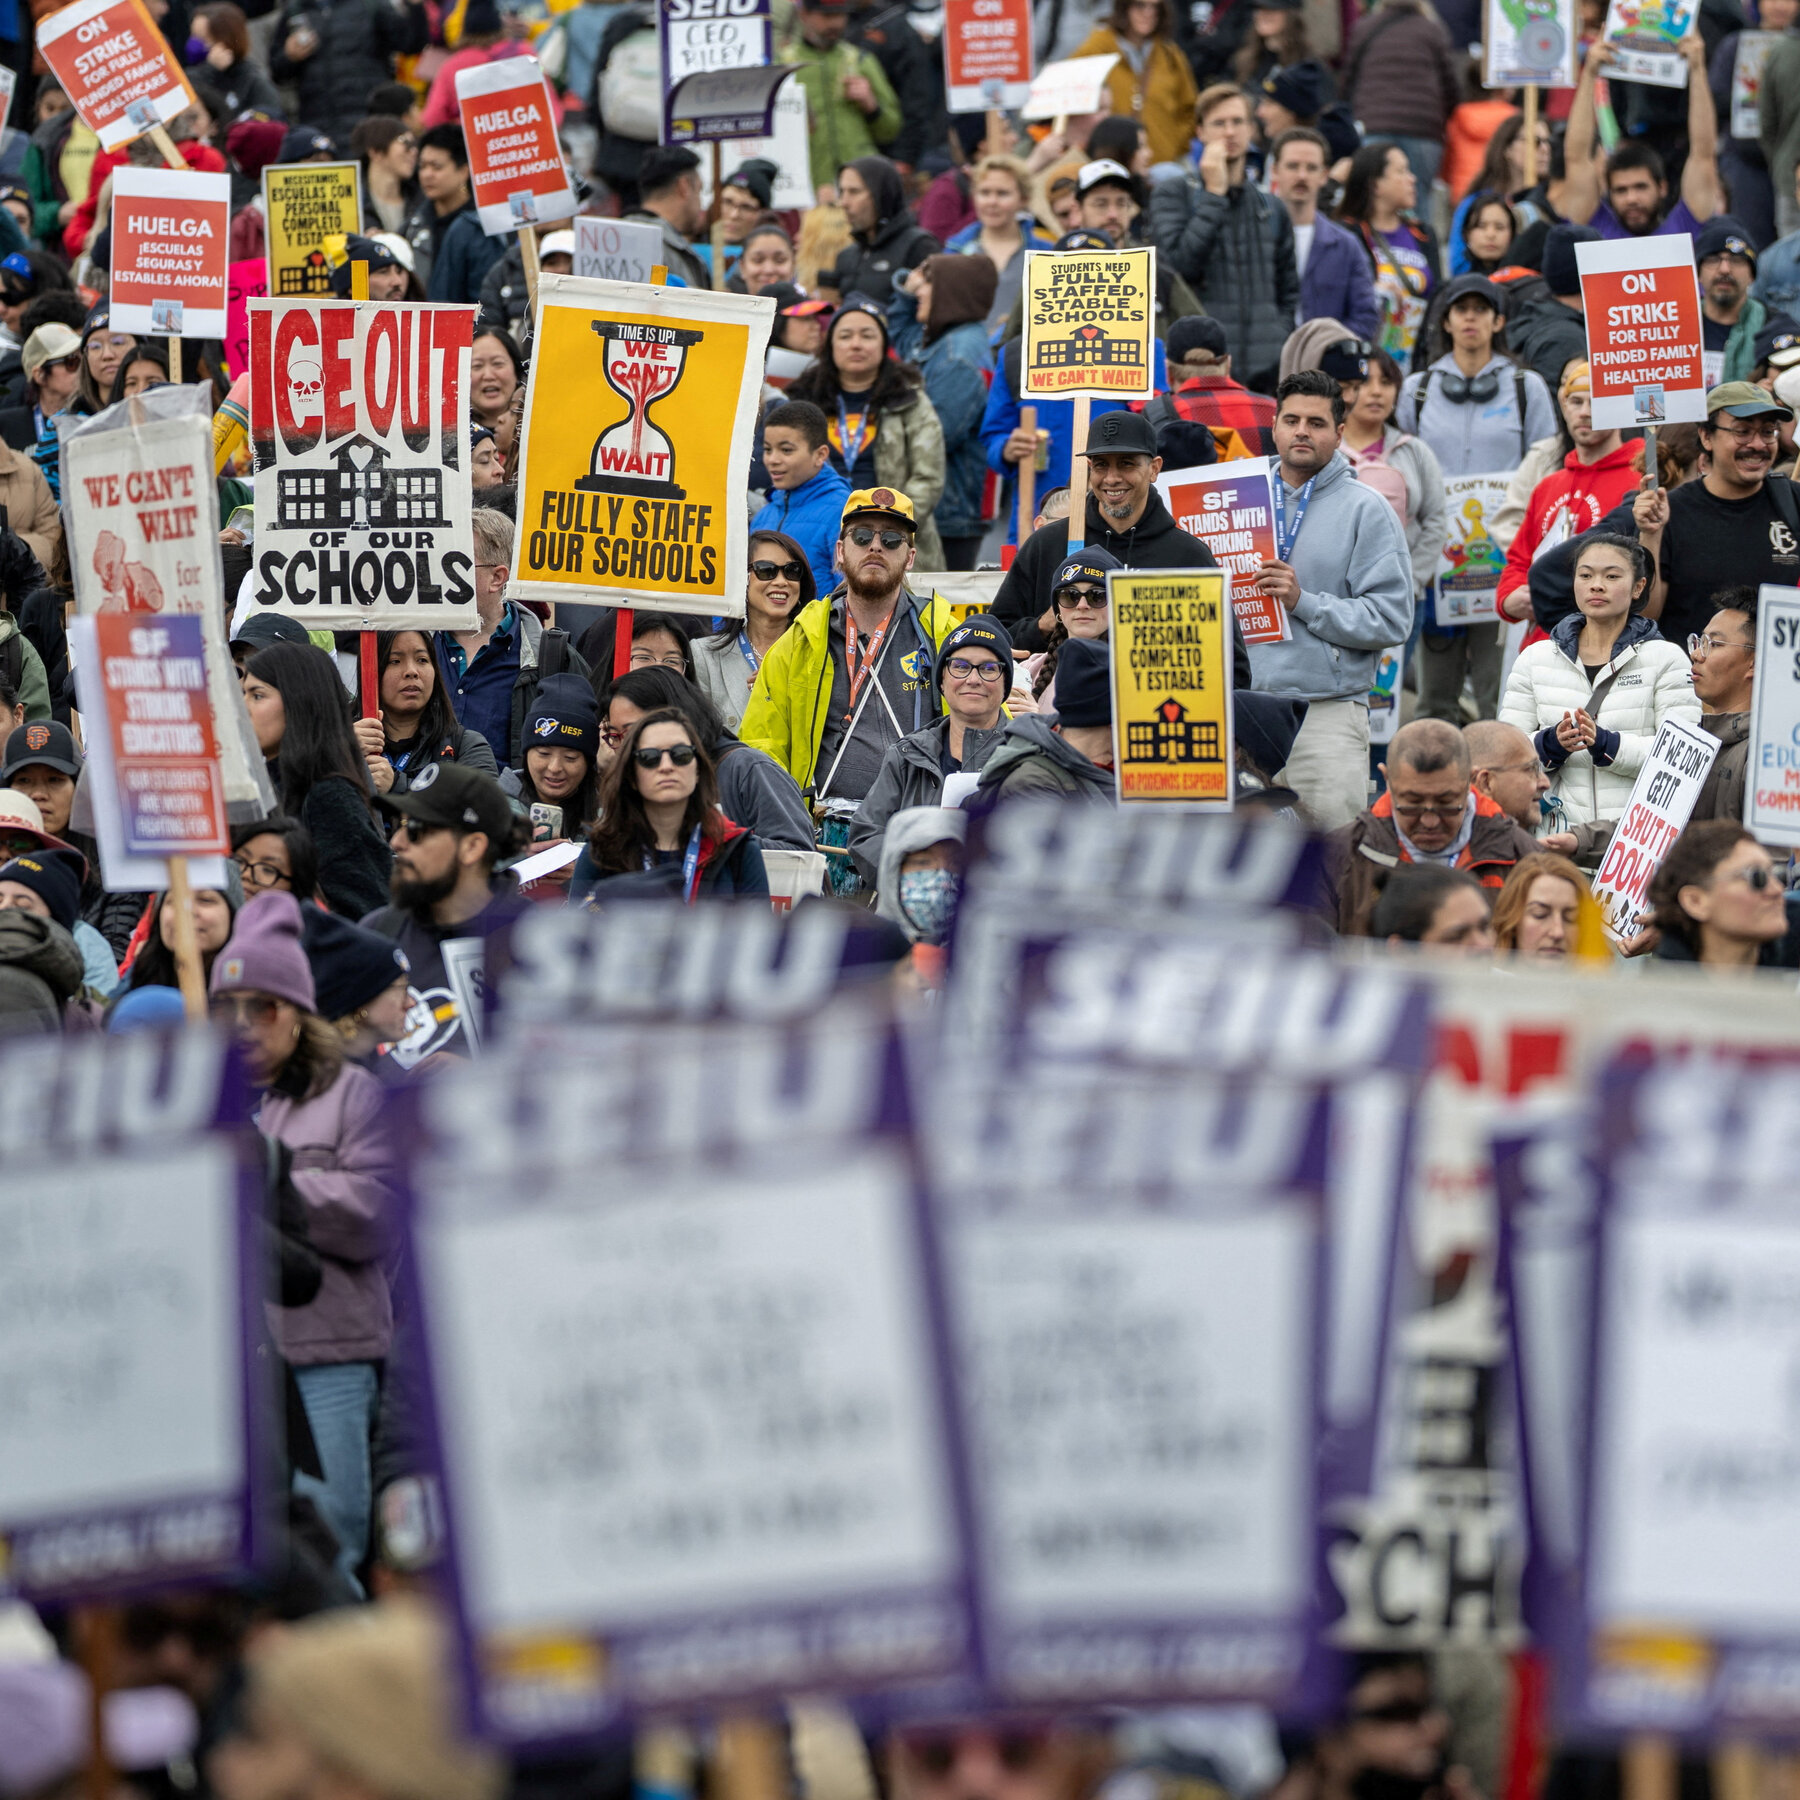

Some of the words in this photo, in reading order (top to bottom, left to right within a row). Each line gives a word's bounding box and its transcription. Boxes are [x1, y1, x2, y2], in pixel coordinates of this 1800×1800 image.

[76, 16, 108, 42] ON
[74, 30, 138, 74] STRIKE
[82, 66, 110, 88] FOR
[108, 48, 143, 72] FULLY
[78, 76, 124, 110] FUNDED
[124, 52, 166, 82] FAMILY
[94, 72, 168, 120] HEALTHCARE
[474, 104, 542, 135] HUELGA
[486, 130, 538, 154] ¡ESCUELAS
[487, 148, 532, 168] SEGURAS
[532, 146, 540, 158] Y
[474, 166, 518, 186] ESTABLES
[520, 157, 560, 176] AHORA!
[272, 186, 327, 200] ESCUELAS
[332, 184, 352, 198] CON
[285, 201, 341, 216] PERSONAL
[128, 215, 214, 238] HUELGA
[282, 216, 342, 232] COMPLETO
[138, 242, 204, 256] ¡ESCUELAS
[286, 234, 292, 246] Y
[298, 231, 343, 246] ESTA
[580, 226, 620, 254] NO
[136, 257, 192, 271] SEGURAS
[194, 260, 203, 272] Y
[580, 256, 644, 283] PARAS
[1051, 262, 1101, 274] STUDENTS
[1105, 262, 1130, 272] NEED
[114, 271, 172, 286] ESTABLES
[174, 275, 224, 288] AHORA!
[1052, 272, 1127, 286] FULLY
[1621, 272, 1656, 294] ON
[1034, 284, 1144, 300] STAFFED,
[1041, 298, 1130, 312] STABLE
[1608, 301, 1679, 326] STRIKE
[1034, 310, 1144, 325] SCHOOLS
[618, 324, 644, 341] TIME
[645, 326, 656, 342] IS
[658, 328, 676, 345] UP!
[1608, 330, 1637, 344] FOR
[1640, 326, 1680, 342] FULLY
[624, 340, 668, 361] WE
[1593, 349, 1647, 366] FUNDED
[1650, 344, 1699, 361] FAMILY
[610, 360, 676, 382] CAN'T
[1032, 372, 1054, 386] WE
[1058, 370, 1098, 386] CAN'T
[1102, 369, 1142, 386] WAIT!
[1604, 364, 1692, 385] HEALTHCARE
[250, 308, 356, 472] ICE
[364, 310, 475, 472] OUT
[600, 446, 670, 476] WAIT
[83, 473, 120, 508] WE
[125, 464, 195, 502] CAN'T
[1454, 480, 1484, 493] CAN'T
[1488, 480, 1510, 491] WAI
[1202, 489, 1238, 511] SF
[137, 506, 198, 544] WAIT
[540, 490, 624, 536] FULLY
[631, 500, 712, 544] STAFF
[1178, 510, 1228, 534] STANDS
[1232, 506, 1266, 528] WITH
[309, 532, 347, 548] OF
[368, 532, 434, 548] OUR
[528, 530, 584, 572] OUR
[593, 536, 716, 585] SCHOOLS
[176, 561, 202, 586] for
[254, 550, 474, 606] SCHOOLS
[1118, 603, 1183, 624] ESCUELAS
[1189, 603, 1218, 622] CON
[1251, 616, 1271, 630] FOR
[129, 627, 170, 655] SF
[1133, 626, 1202, 646] PERSONAL
[1774, 616, 1800, 648] SY
[1130, 648, 1201, 668] COMPLETO
[163, 656, 205, 690] WITH
[1134, 672, 1142, 691] Y
[1148, 670, 1204, 690] ESTABLE
[560, 725, 583, 738] UESF
[1652, 727, 1671, 760] IF
[1664, 734, 1686, 768] WE
[1678, 745, 1710, 782] DON'T
[1646, 770, 1672, 806] GET
[1664, 778, 1681, 810] IT
[1622, 803, 1666, 850] SHUT
[1655, 825, 1679, 860] IT
[988, 803, 1303, 902] SEIU
[510, 903, 849, 1014] SEIU
[1035, 940, 1400, 1076] SEIU
[422, 1005, 884, 1170] SEIU
